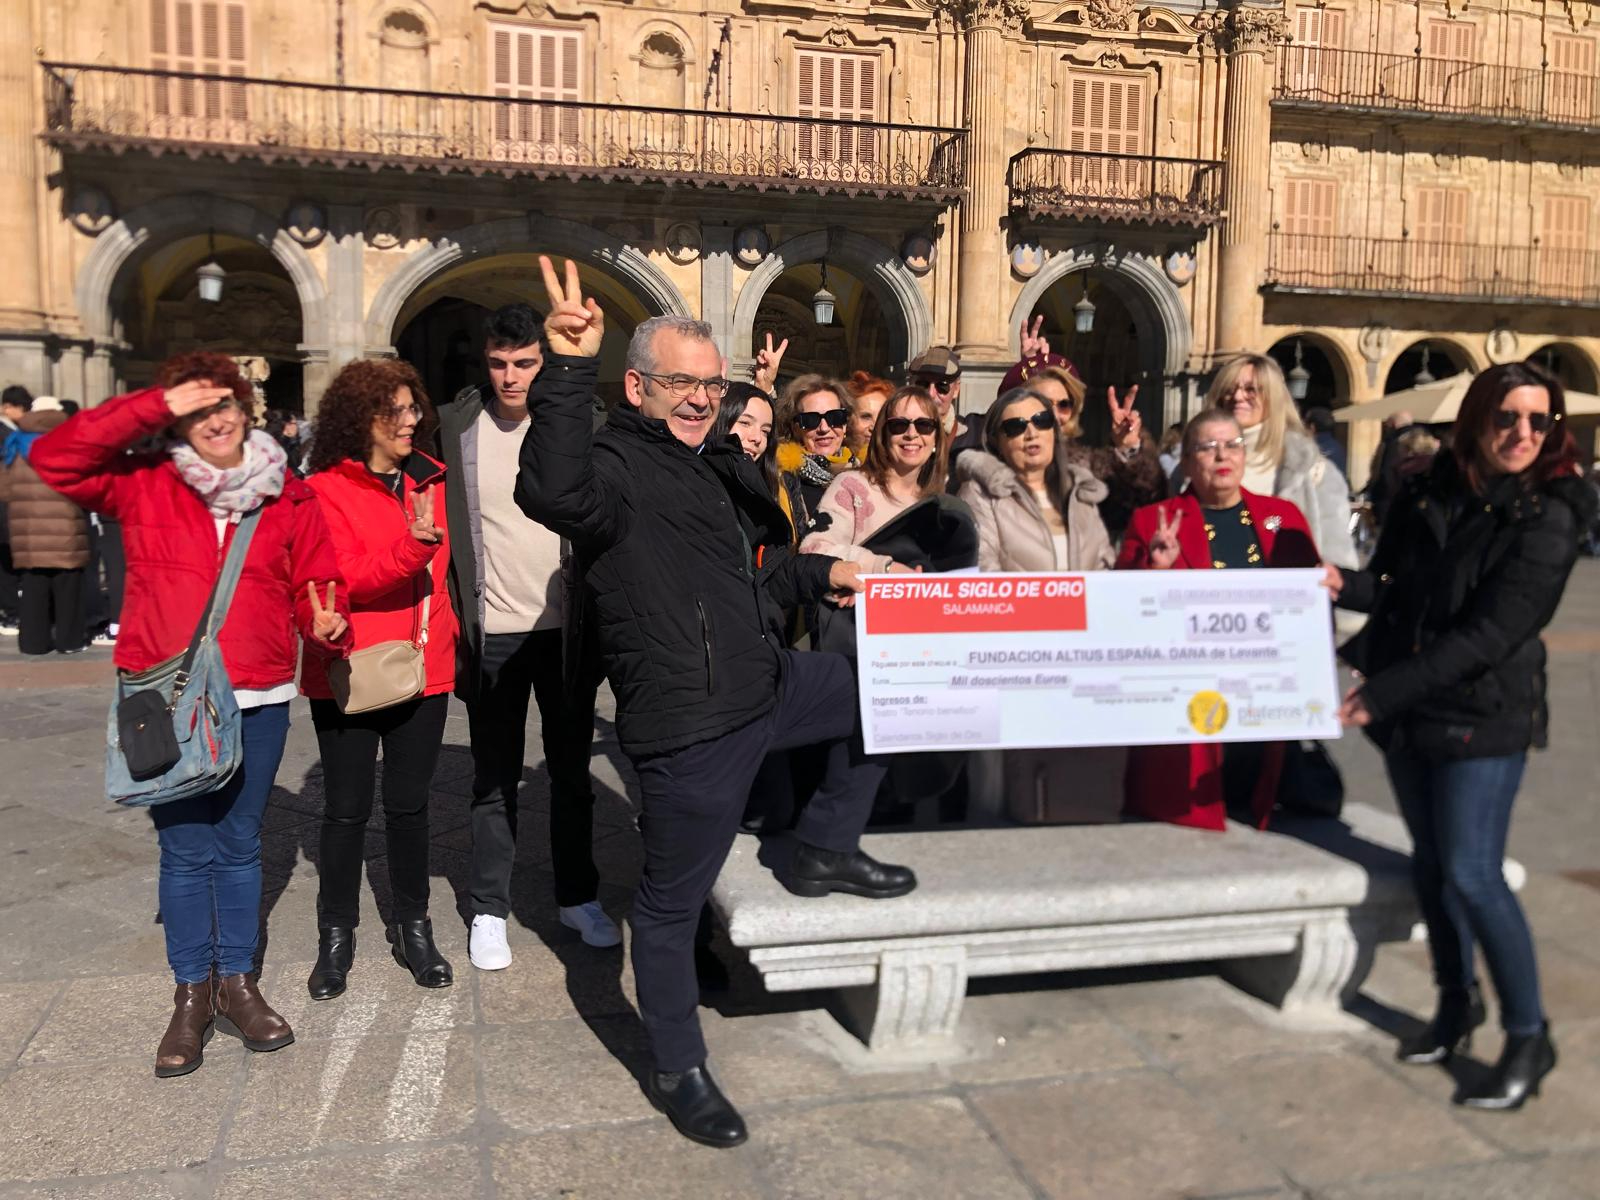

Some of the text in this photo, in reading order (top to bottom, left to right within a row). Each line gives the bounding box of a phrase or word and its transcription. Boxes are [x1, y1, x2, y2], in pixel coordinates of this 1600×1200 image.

[870, 581, 1084, 599] FESTIVAL SIGLO DE ORO
[942, 602, 1015, 615] SALAMANCA
[1188, 612, 1272, 634] 1.200 €
[969, 650, 1053, 664] FUNDACION
[1056, 649, 1103, 662] ALTIUS
[1211, 648, 1226, 659] de
[951, 674, 1069, 686] Mil doscientos Euros
[872, 696, 911, 706] Ingresos
